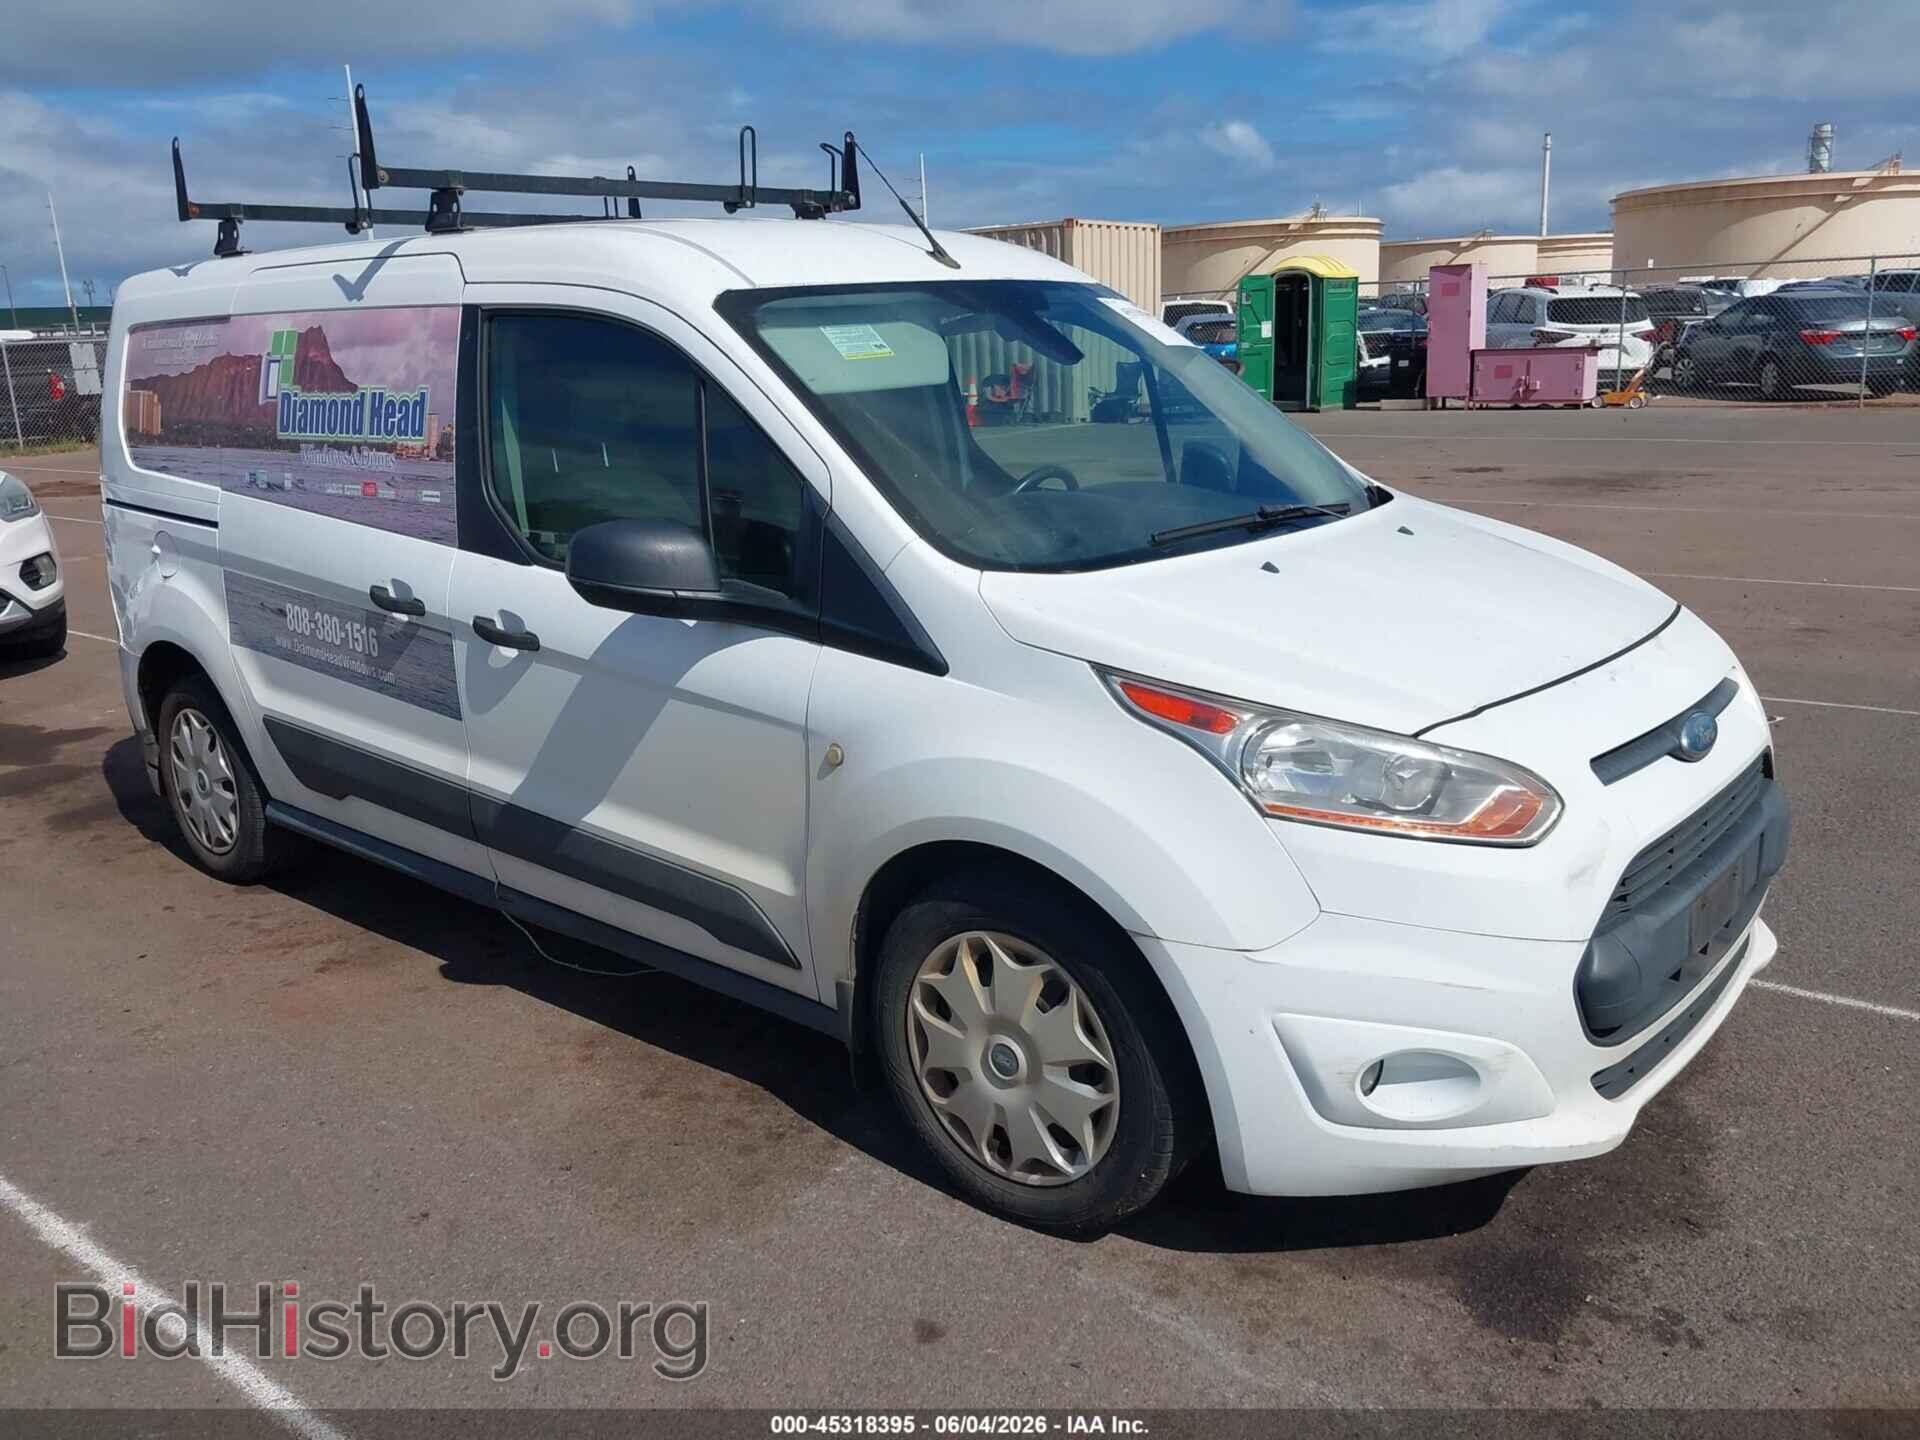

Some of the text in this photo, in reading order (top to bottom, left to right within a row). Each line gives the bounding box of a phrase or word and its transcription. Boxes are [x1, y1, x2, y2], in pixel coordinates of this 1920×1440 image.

[278, 390, 427, 438] Diamond Head
[286, 603, 379, 658] 808-380-1516
